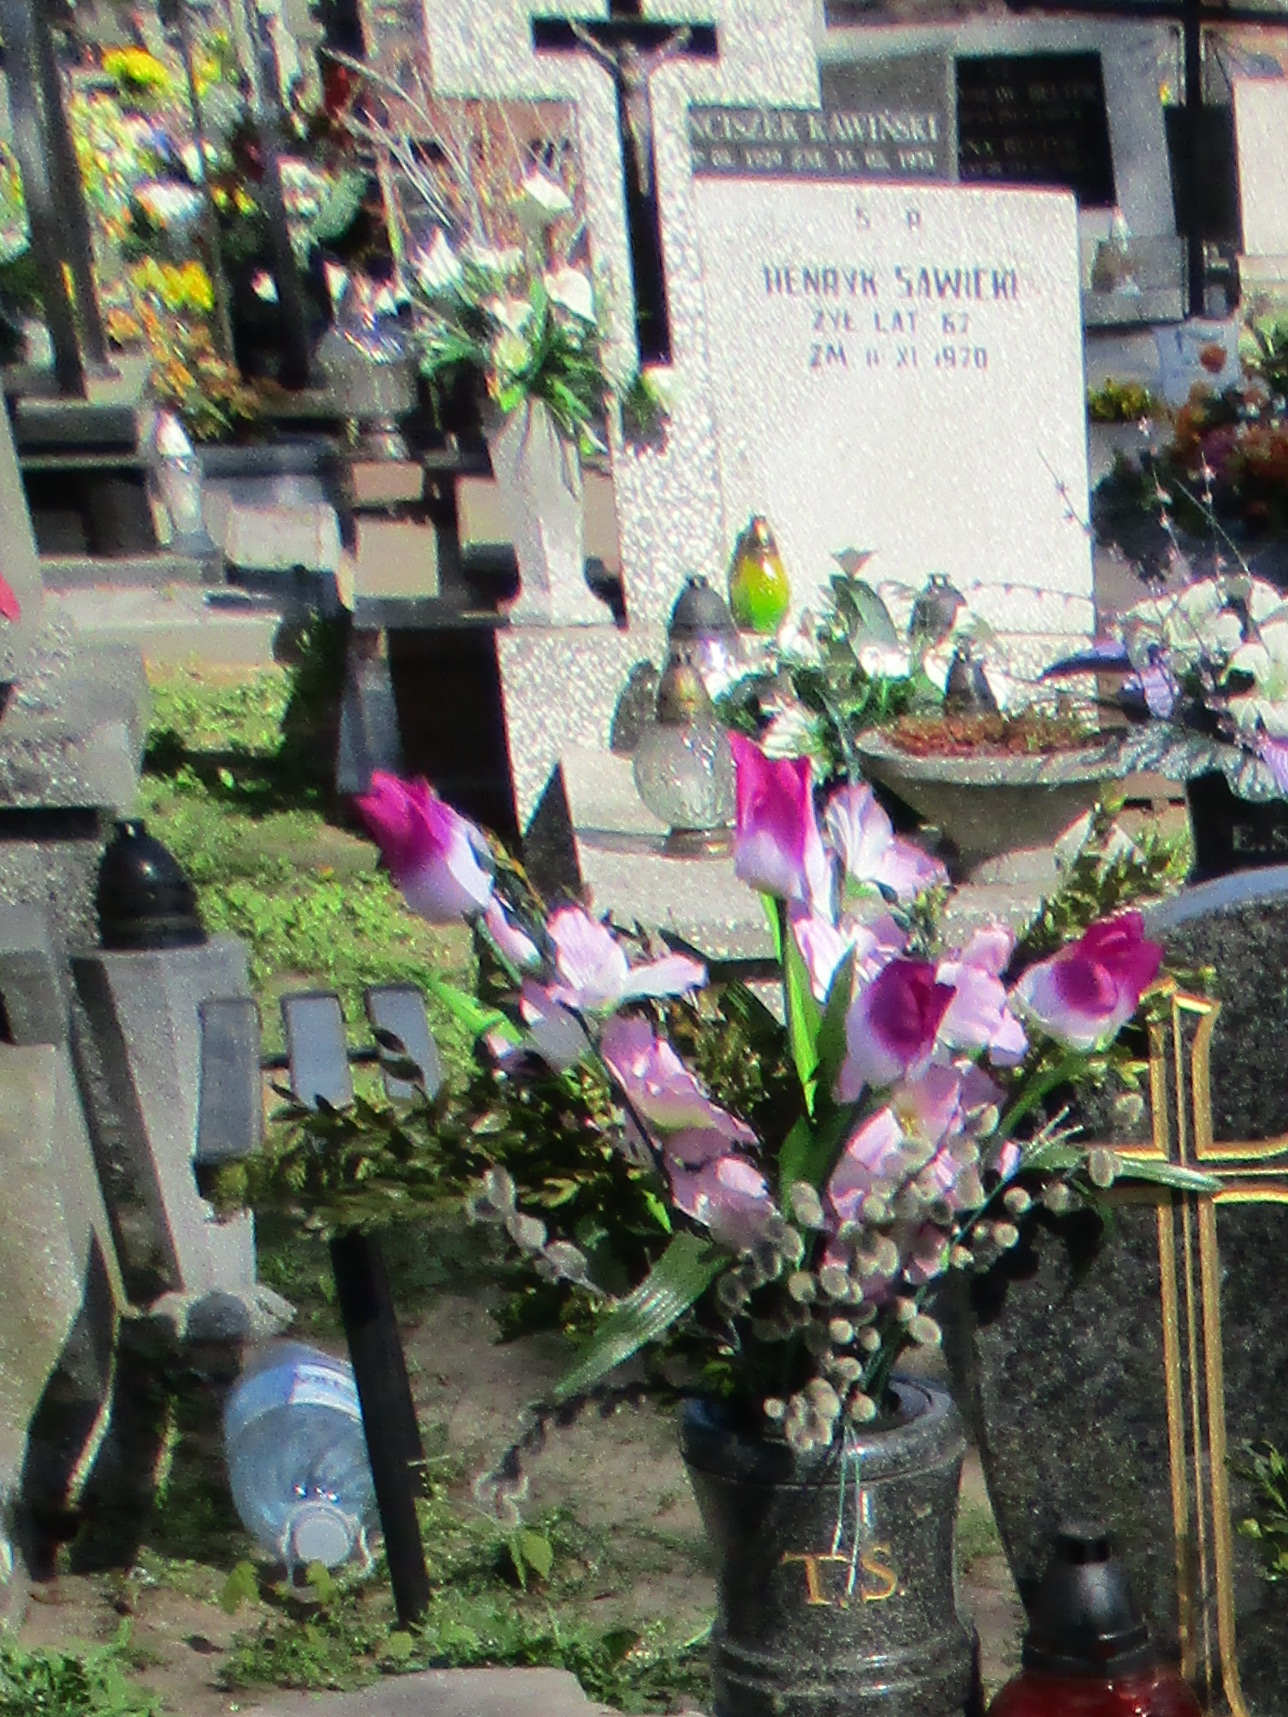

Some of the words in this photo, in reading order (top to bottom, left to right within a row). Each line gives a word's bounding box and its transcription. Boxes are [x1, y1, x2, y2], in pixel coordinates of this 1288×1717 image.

[763, 264, 877, 296] HENRYK
[894, 264, 1018, 300] SAWICKI
[873, 309, 916, 333] LAT
